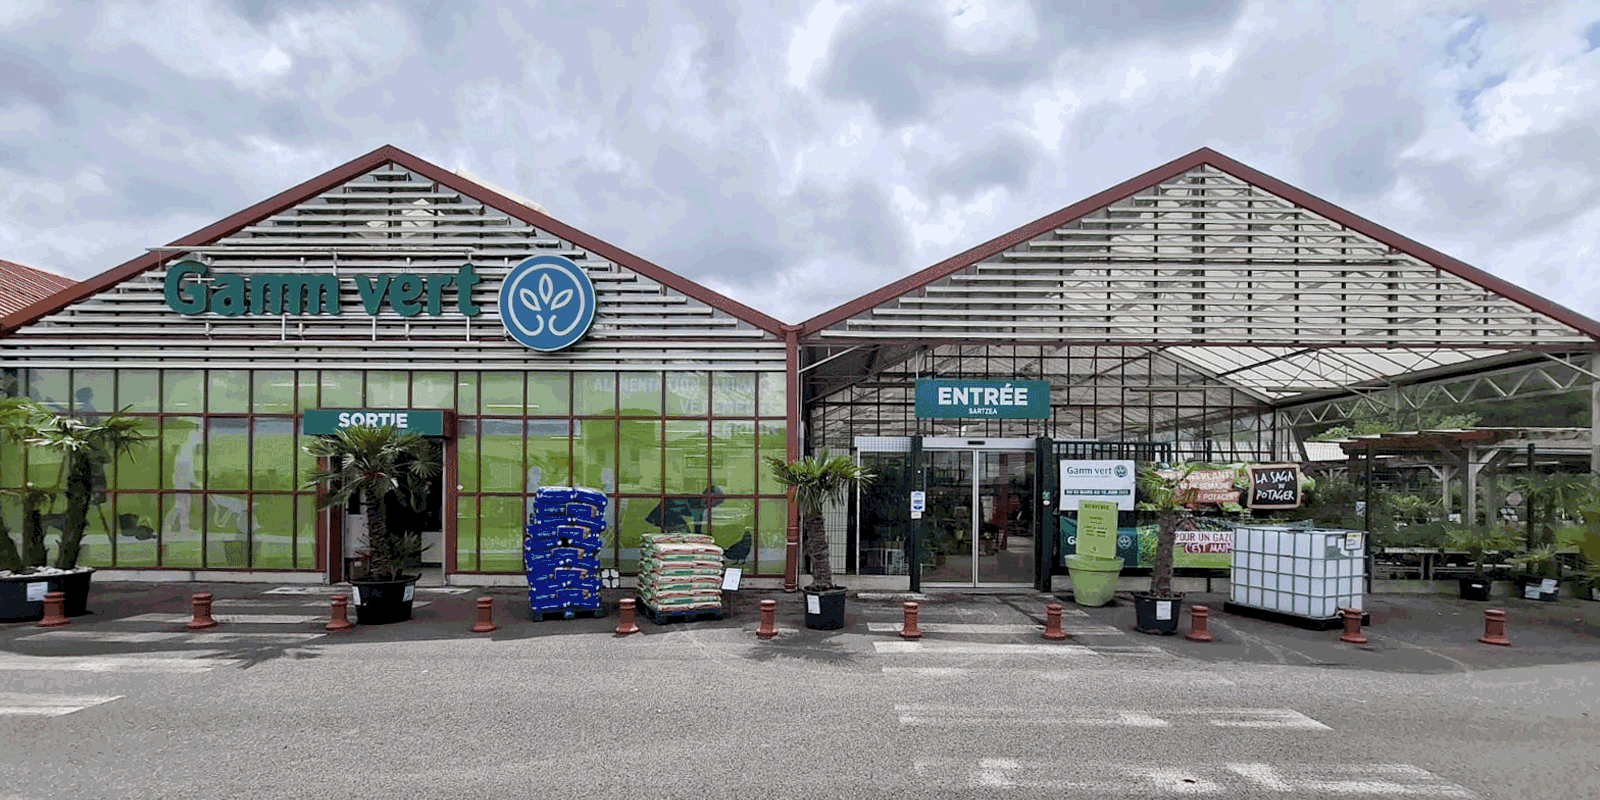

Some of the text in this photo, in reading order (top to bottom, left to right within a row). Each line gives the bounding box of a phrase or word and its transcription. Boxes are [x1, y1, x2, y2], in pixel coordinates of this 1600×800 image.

[163, 260, 481, 317] Gamm vert
[594, 377, 701, 392] ALMENTATION
[938, 382, 1028, 406] ENTRÉE
[968, 407, 998, 415] SARTZEA
[338, 412, 408, 429] SORTIE
[1066, 466, 1112, 475] Gamm vert
[1255, 470, 1294, 484] LA SAGA
[1256, 489, 1295, 501] POTAGER
[1175, 532, 1195, 542] POUR
[1199, 532, 1209, 542] UN
